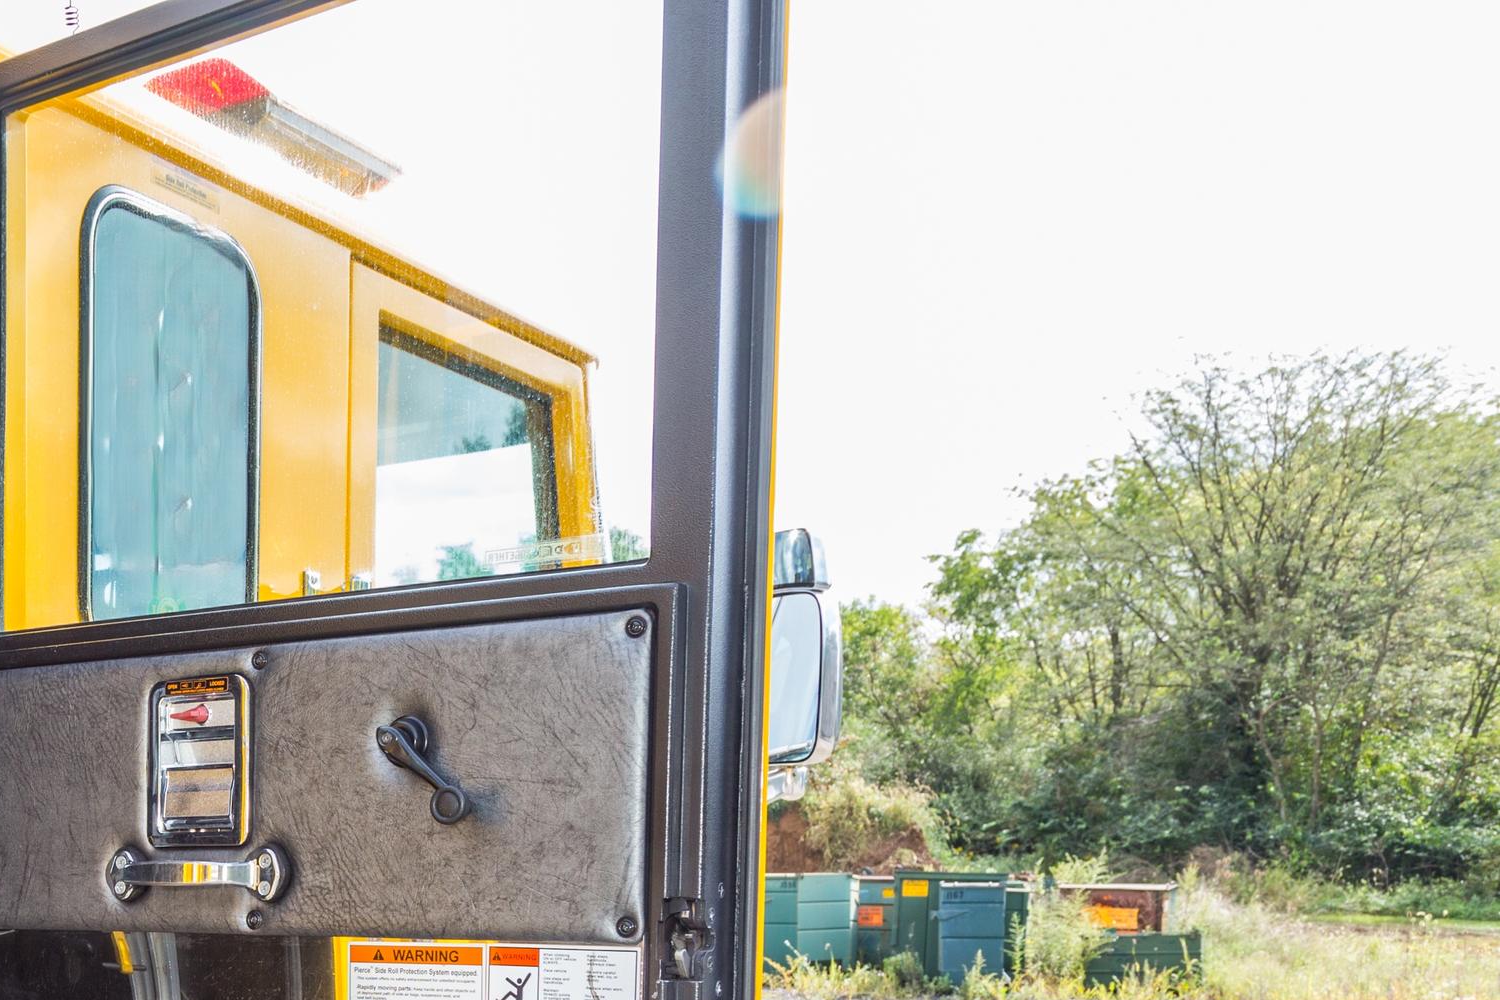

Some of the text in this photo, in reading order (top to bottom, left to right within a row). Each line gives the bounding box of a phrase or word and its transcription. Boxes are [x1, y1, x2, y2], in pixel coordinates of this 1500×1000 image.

[392, 949, 459, 963] WARNING
[501, 953, 537, 961] WARNING
[388, 967, 399, 975] Roll
[399, 968, 428, 976] Protection
[429, 969, 450, 977] System
